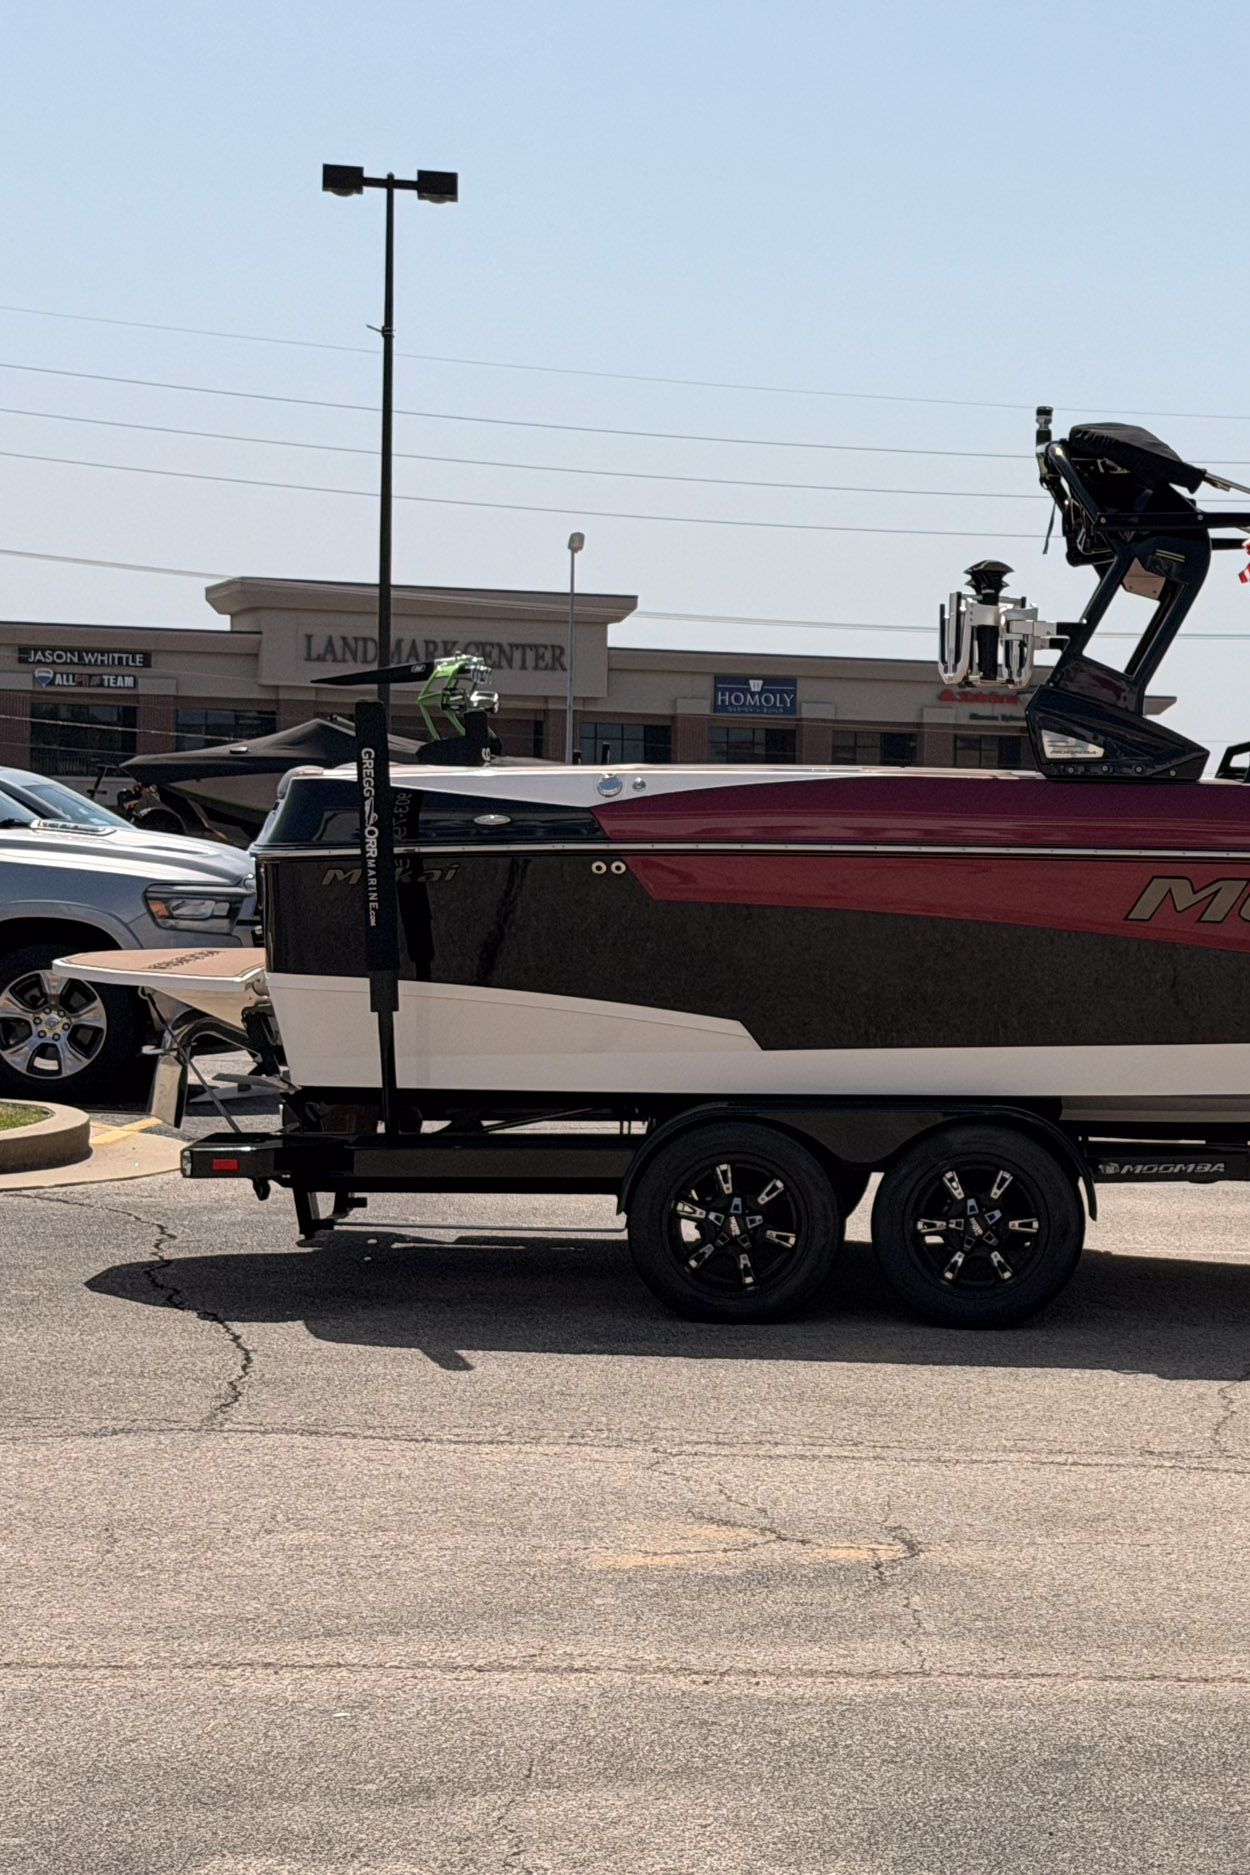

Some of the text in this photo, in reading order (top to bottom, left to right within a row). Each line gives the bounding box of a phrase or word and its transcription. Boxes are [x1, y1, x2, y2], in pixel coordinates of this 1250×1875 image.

[28, 650, 144, 666] JASON WHITTLE
[102, 675, 134, 688] TEAM
[717, 691, 795, 707] HOMOLY
[361, 747, 375, 797] GREGG
[322, 863, 460, 886] Mkai
[1120, 1162, 1225, 1175] MOOMBA
